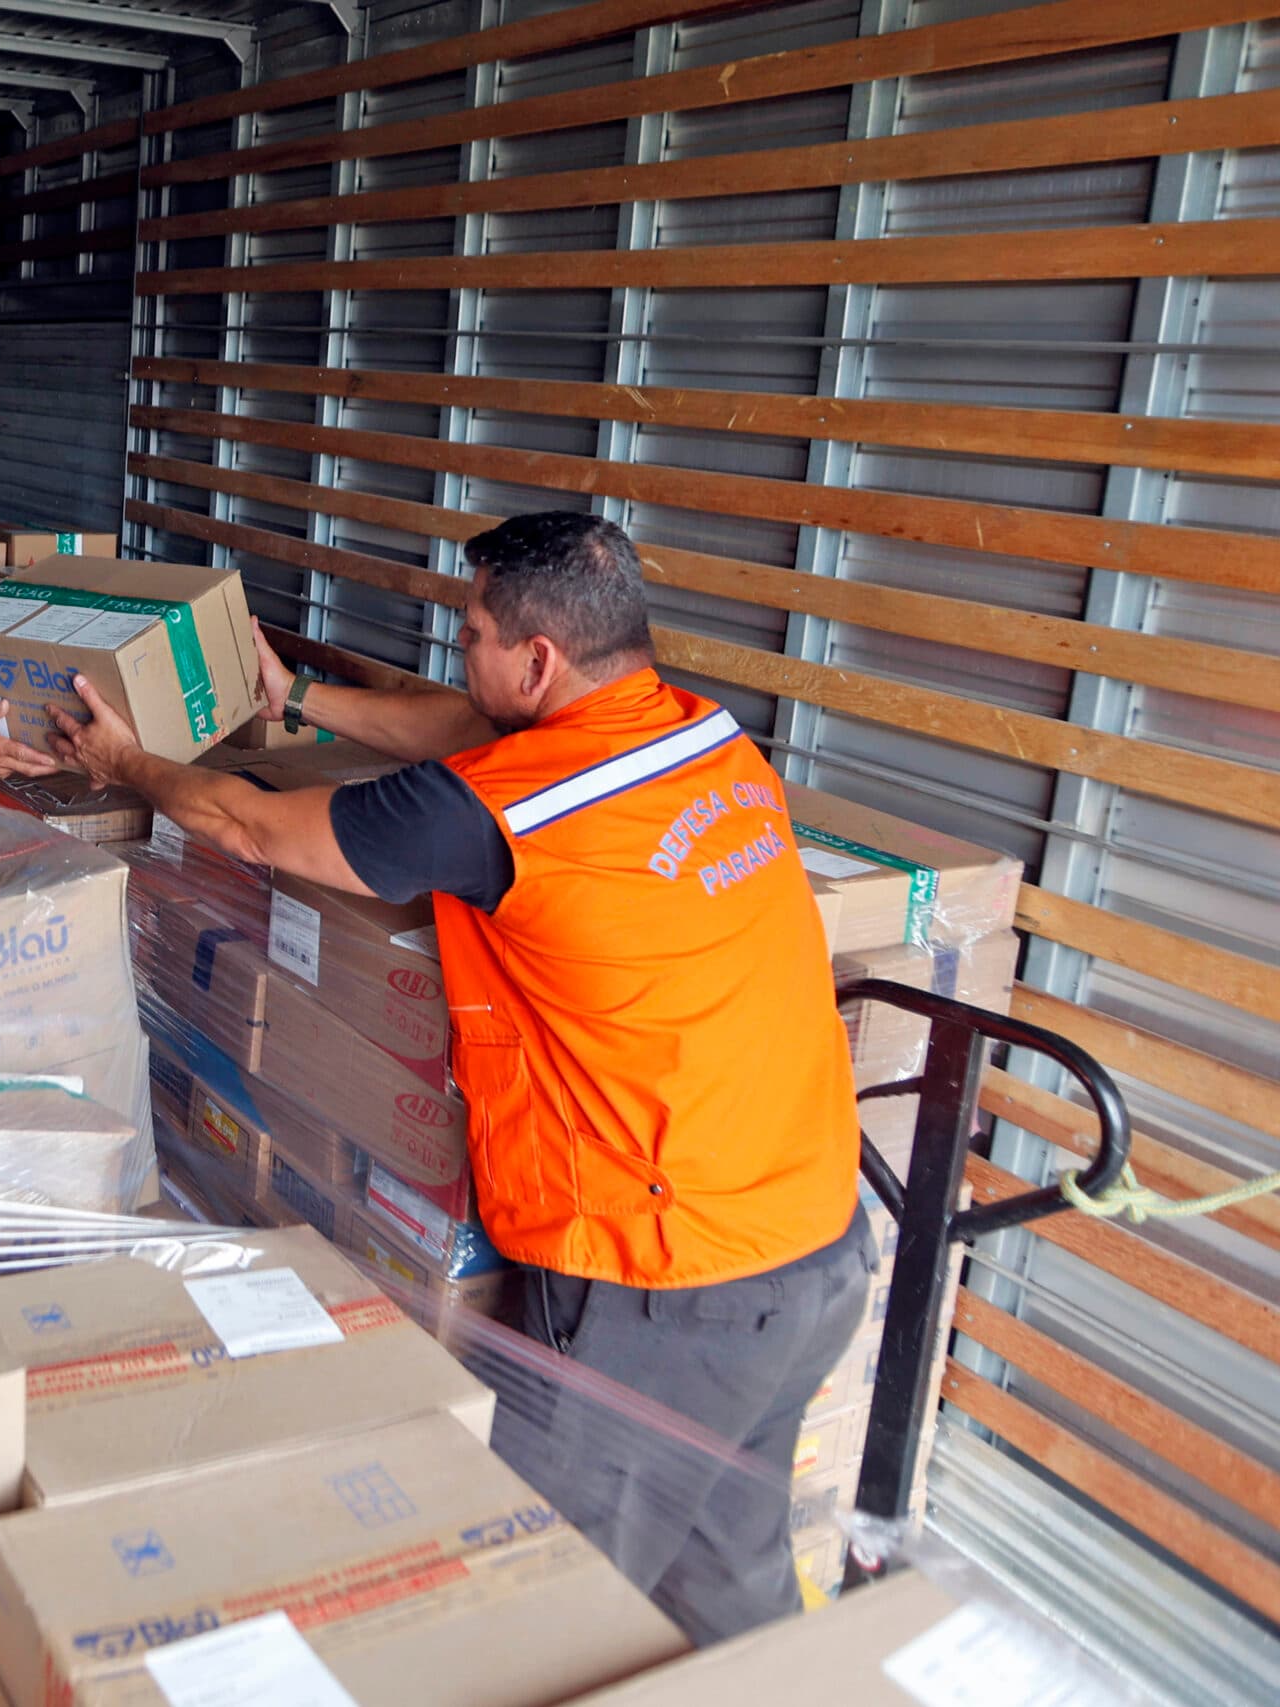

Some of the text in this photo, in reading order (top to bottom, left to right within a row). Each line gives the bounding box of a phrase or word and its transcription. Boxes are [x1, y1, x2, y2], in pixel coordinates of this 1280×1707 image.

[648, 782, 784, 880] DEFESA CIVIL
[699, 822, 786, 897] PARANÁ
